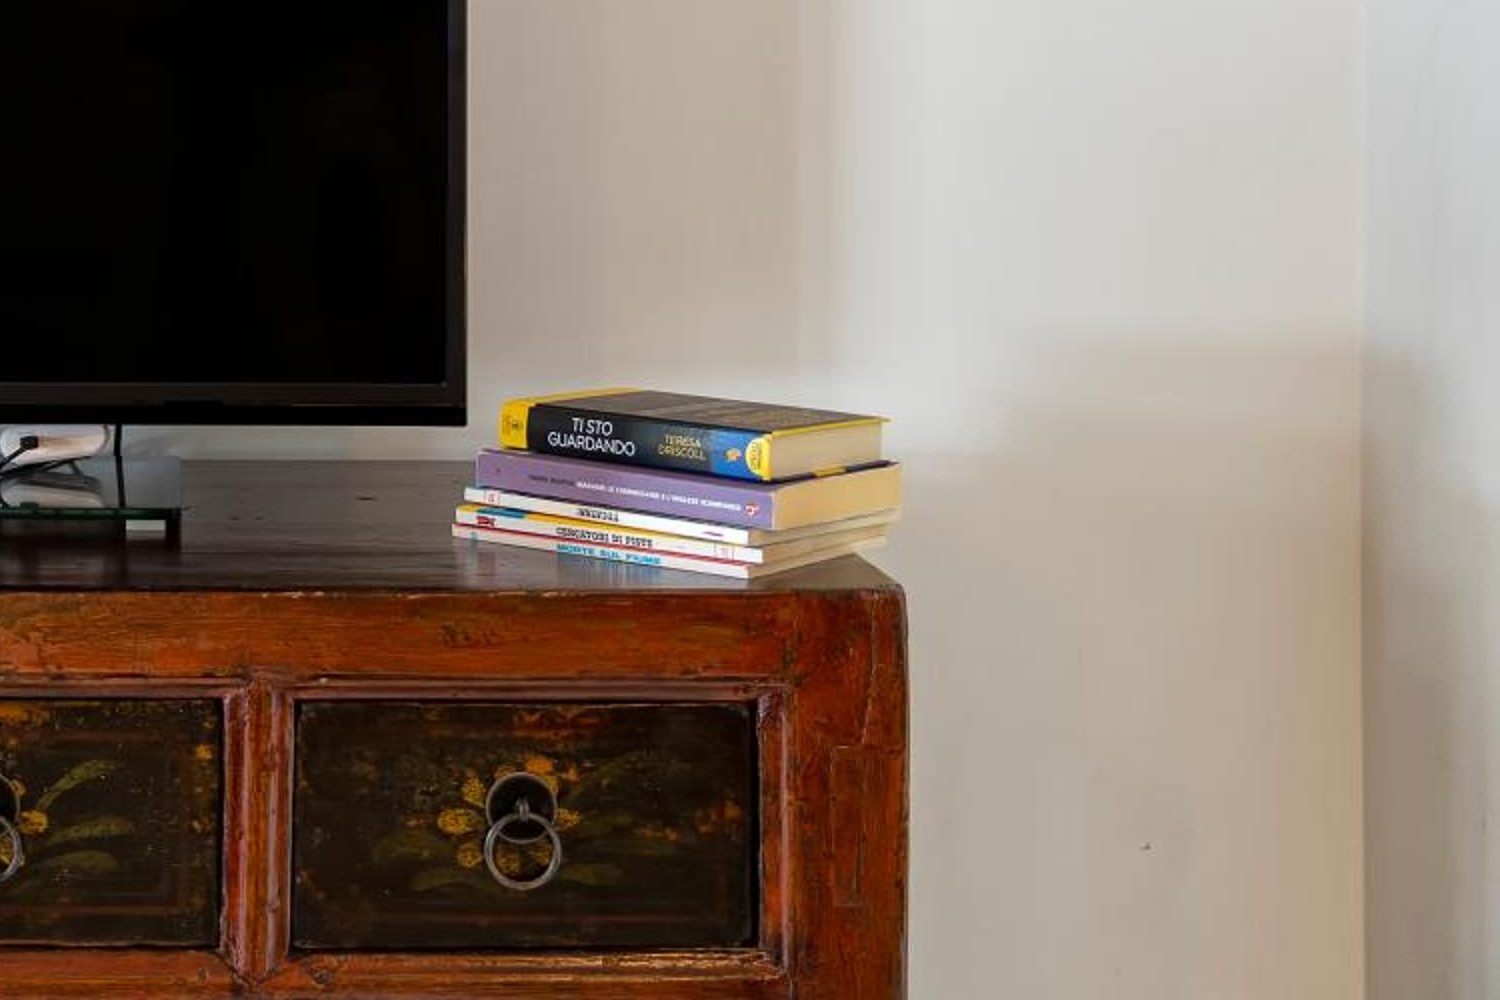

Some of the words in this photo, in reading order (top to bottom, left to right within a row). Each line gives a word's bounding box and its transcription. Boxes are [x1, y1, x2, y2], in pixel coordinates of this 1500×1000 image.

[572, 417, 585, 433] TI
[585, 419, 613, 437] STO
[547, 431, 635, 457] GUARDANDO
[556, 527, 609, 544] CERCATORI
